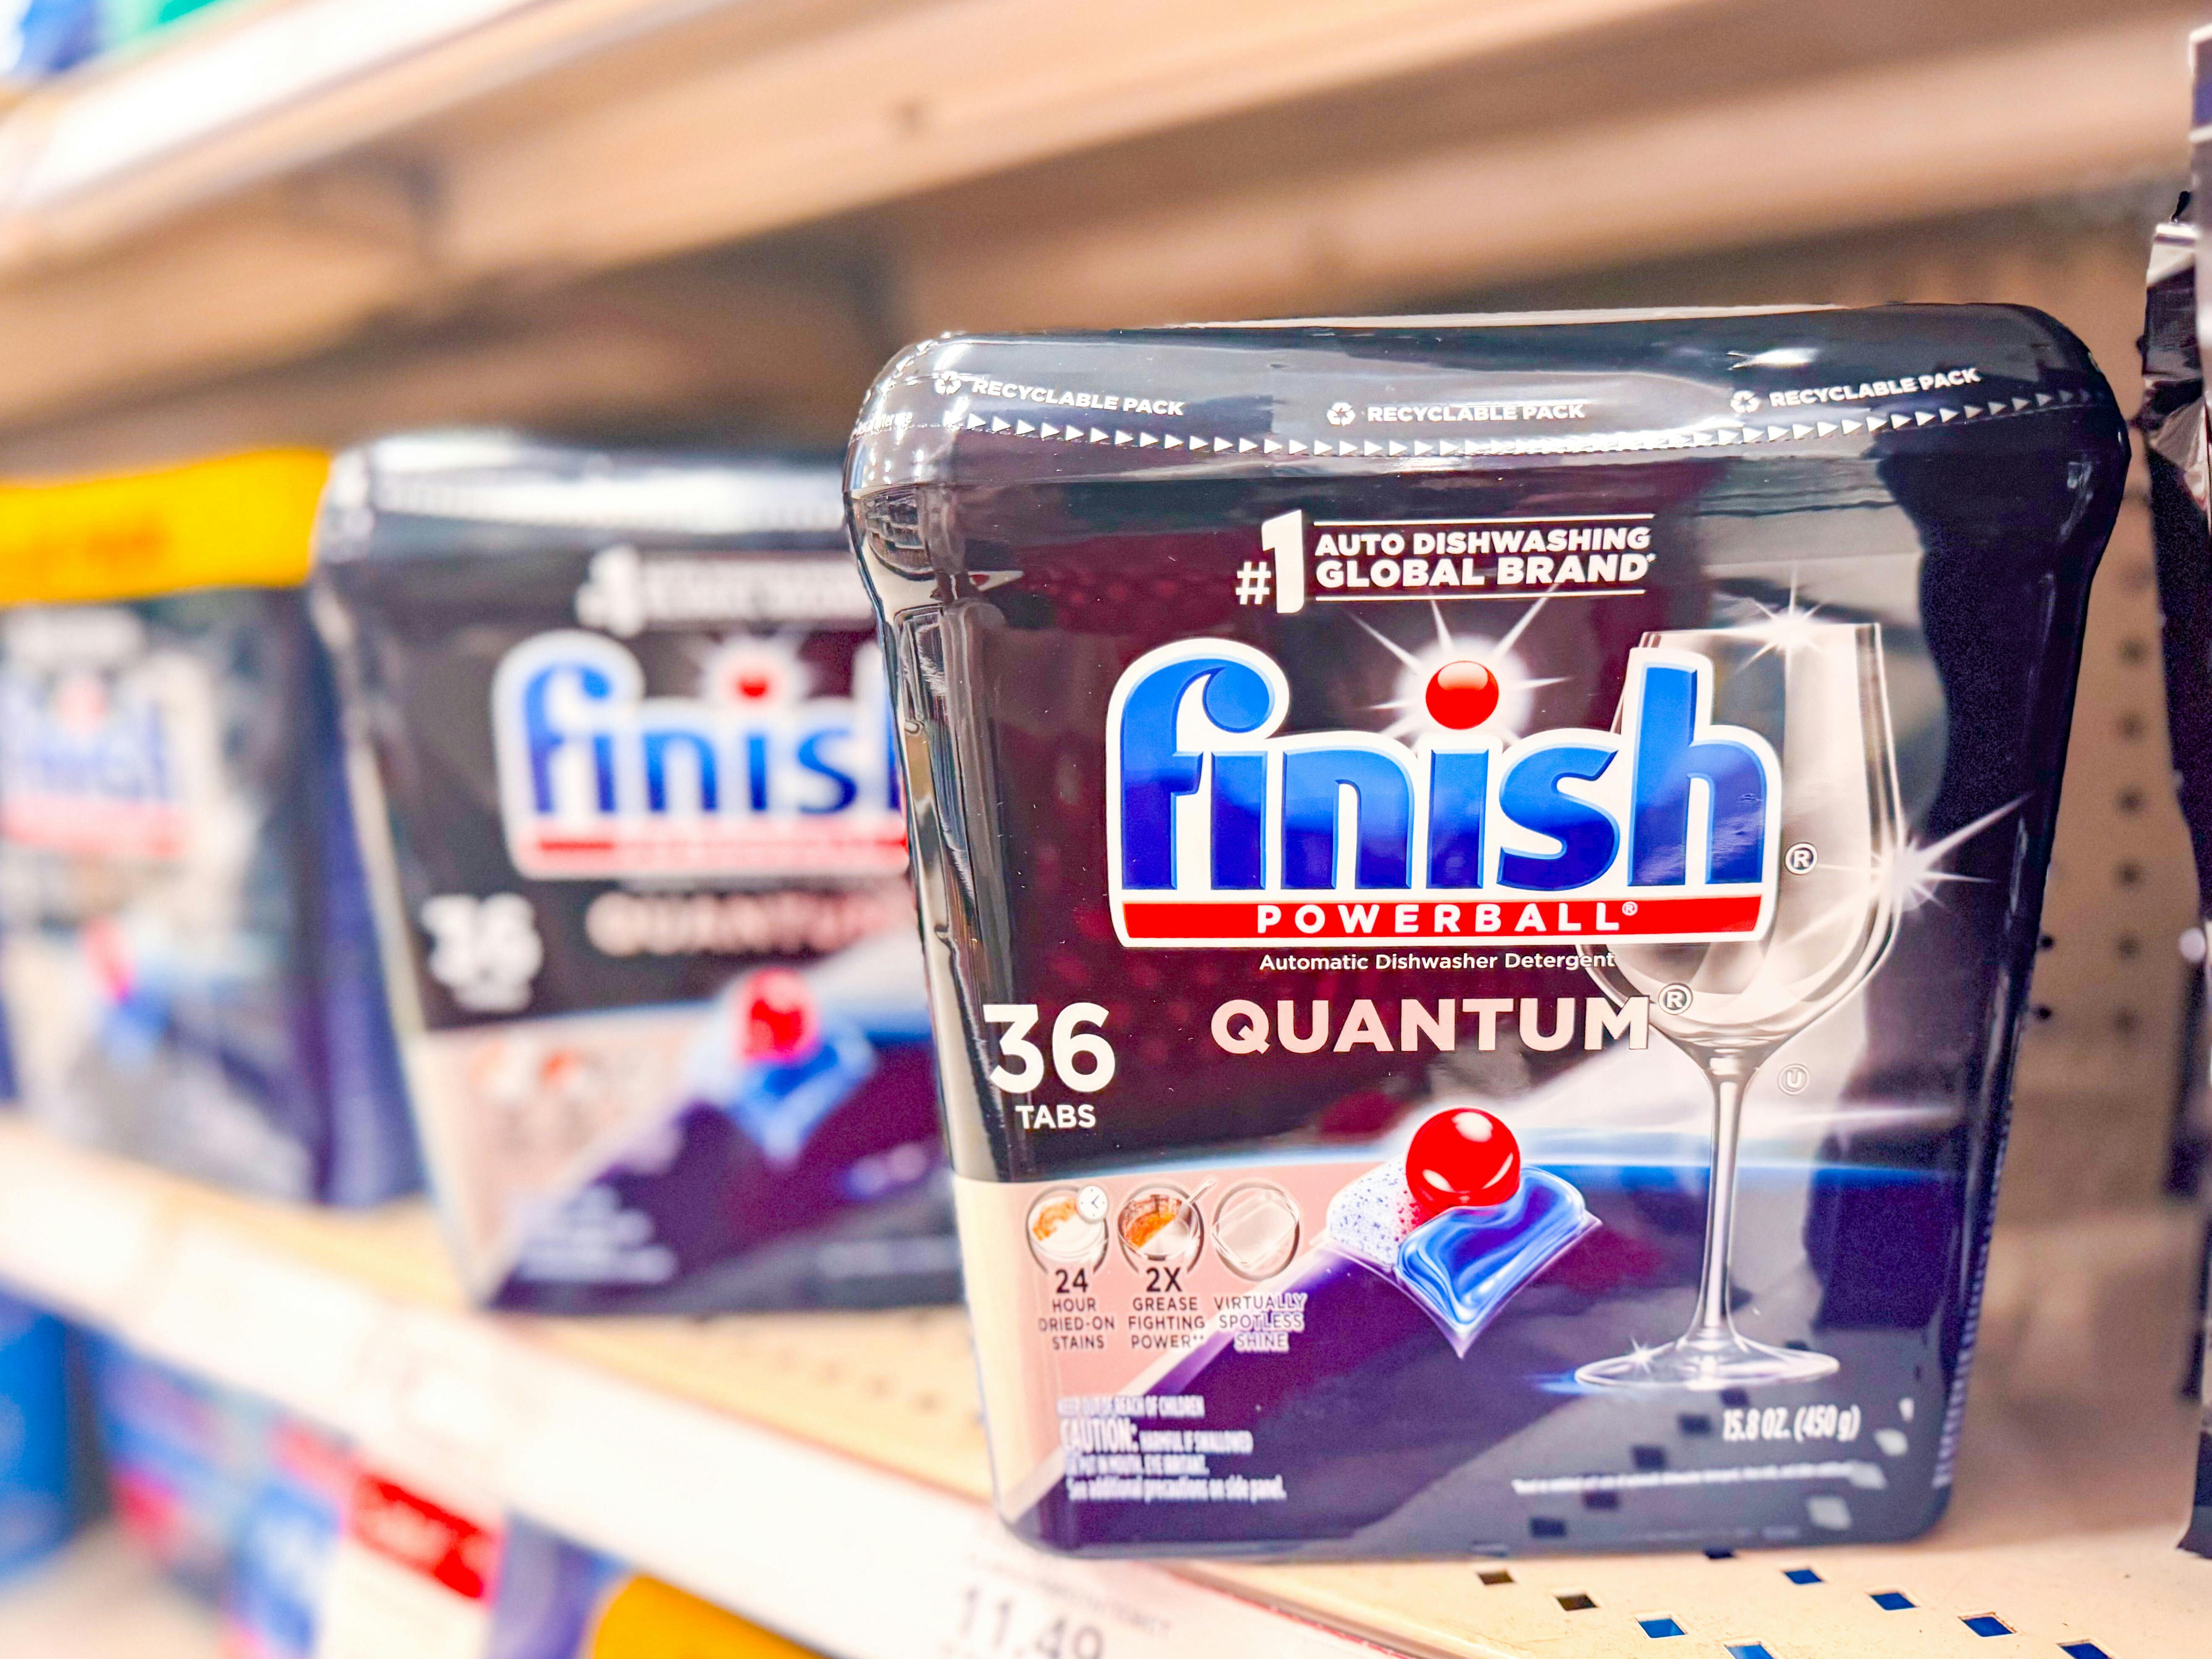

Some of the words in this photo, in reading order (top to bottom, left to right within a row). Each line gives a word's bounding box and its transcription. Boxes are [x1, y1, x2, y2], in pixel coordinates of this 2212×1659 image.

[972, 379, 1119, 411] RECYCLABLE
[1123, 397, 1185, 416] PACK
[1770, 377, 1917, 407] RECYCLABLE
[1919, 367, 1981, 391] PACK
[1367, 405, 1517, 422] RECYCLABLE
[1523, 404, 1585, 420] PACK
[1315, 532, 1405, 556] AUTO
[1413, 527, 1651, 555] DISHWASHING
[1235, 509, 1305, 614] #1
[1316, 559, 1485, 588] GLOBAL
[523, 661, 901, 815] finis
[1259, 952, 1368, 972] Automatic
[1376, 952, 1498, 970] Dishwasher
[1504, 950, 1616, 974] Detergent
[983, 1002, 1115, 1094] 36
[1015, 1104, 1097, 1130] TABS
[1055, 1268, 1089, 1294] 24
[1146, 1267, 1183, 1293] 2X
[1052, 1298, 1097, 1312] HOUR
[1133, 1296, 1198, 1311] GREASE
[1214, 1294, 1306, 1310] VIRTUALLY
[1038, 1316, 1115, 1331] DRIED-ON
[1128, 1315, 1205, 1330] FIGHTING
[1219, 1313, 1302, 1328] SPOTLESS
[1052, 1335, 1105, 1350] STAINS
[1237, 1332, 1286, 1348] SHINE
[1060, 1417, 1139, 1453] CAUTION:
[1723, 1408, 1761, 1441] 15.8
[1761, 1406, 1791, 1440] OZ.
[1794, 1404, 1838, 1442] (450
[1838, 1404, 1862, 1442] g)
